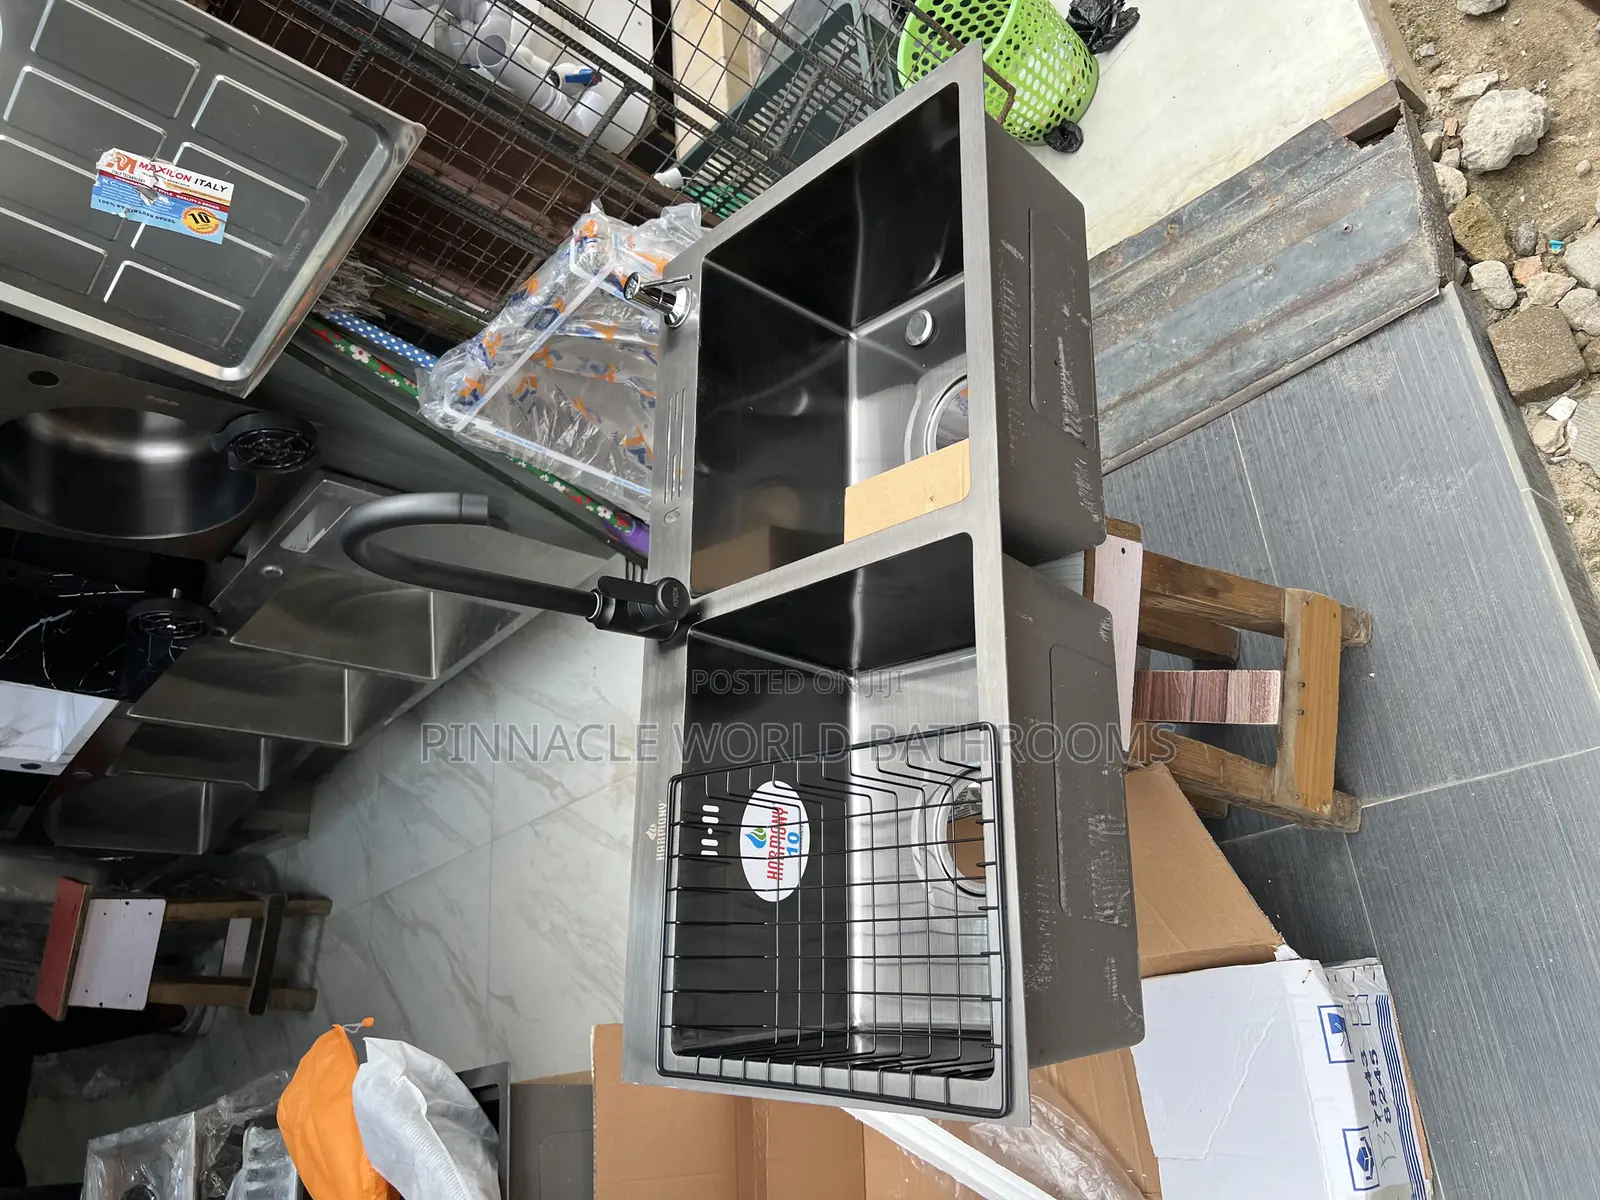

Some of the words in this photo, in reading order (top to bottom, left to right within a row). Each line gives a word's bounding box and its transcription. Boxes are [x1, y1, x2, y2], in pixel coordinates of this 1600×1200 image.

[138, 161, 193, 183] MAXILON
[194, 177, 229, 193] ITALY
[188, 211, 211, 225] 10
[656, 802, 667, 861] HARMONY
[767, 804, 789, 881] HARMONY
[786, 831, 800, 857] 10
